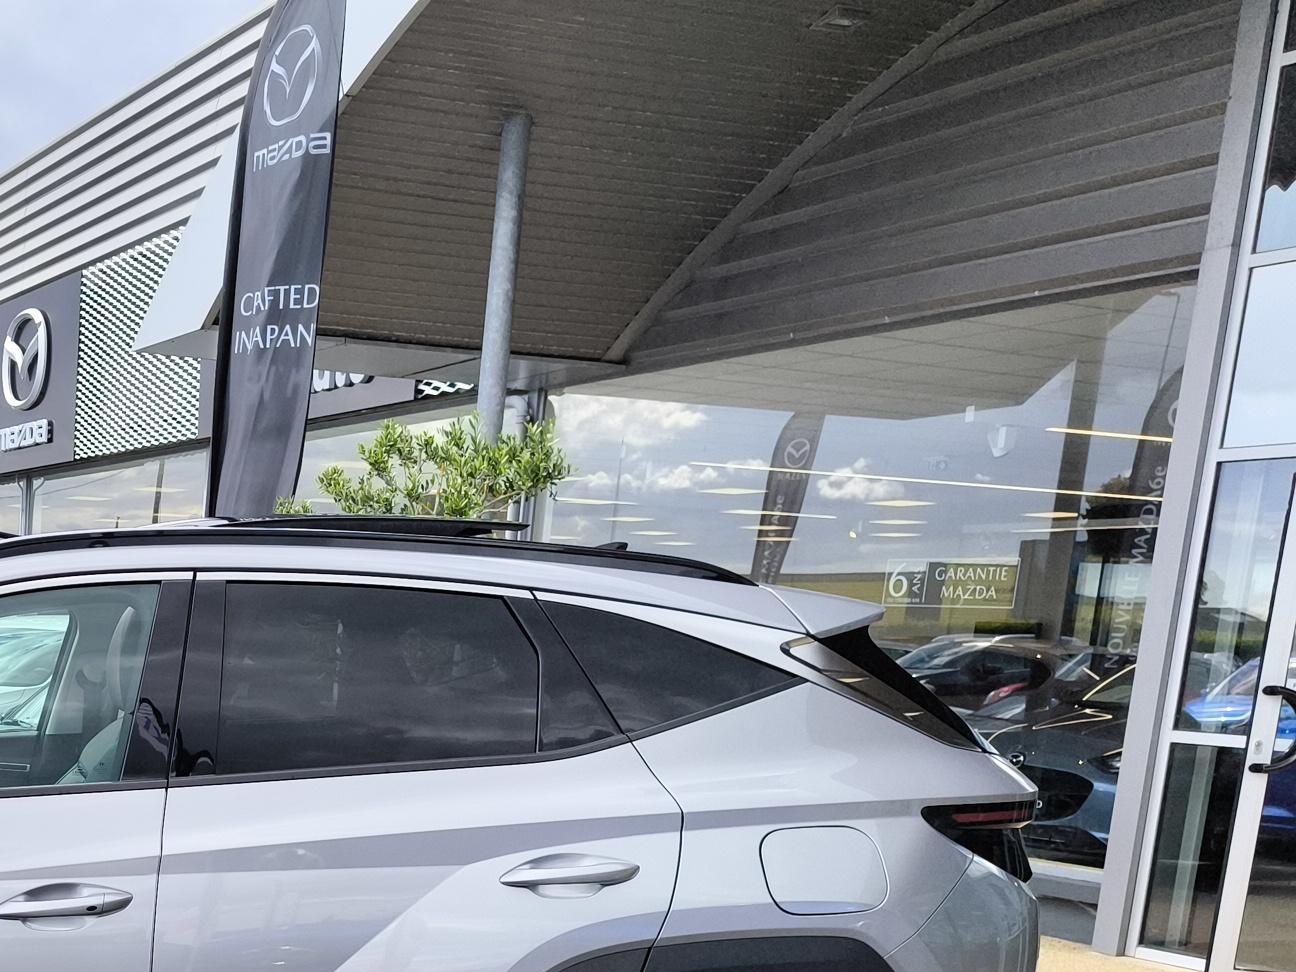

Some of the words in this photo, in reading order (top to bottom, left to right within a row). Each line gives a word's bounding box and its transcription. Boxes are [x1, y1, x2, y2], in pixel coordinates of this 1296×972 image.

[240, 284, 320, 316] CAFTED
[889, 562, 907, 597] 6
[935, 566, 1009, 581] GARANTIE
[940, 585, 997, 600] MAZDA
